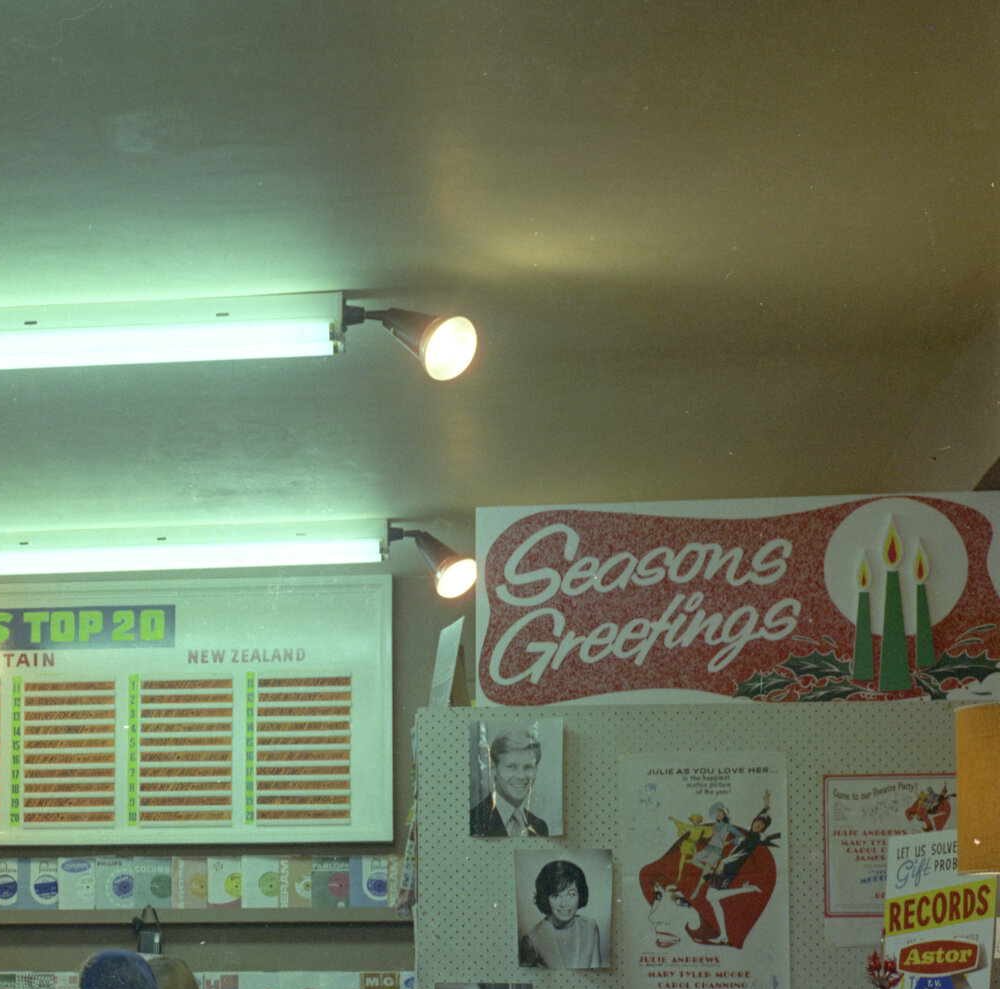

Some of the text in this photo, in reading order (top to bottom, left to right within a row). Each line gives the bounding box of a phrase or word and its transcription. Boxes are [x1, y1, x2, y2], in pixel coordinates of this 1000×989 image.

[495, 522, 793, 608] Seasons
[23, 609, 103, 643] TOP
[111, 608, 166, 642] 20
[488, 590, 802, 687] Greetings
[187, 647, 307, 664] NEW ZEALAND
[647, 768, 674, 776] JULIE
[693, 767, 715, 775] YOU
[897, 840, 958, 860] LET US SOLVE
[894, 857, 931, 889] Gift
[888, 884, 991, 933] RECORDS
[639, 955, 721, 963] JULIE ANDREWS
[903, 946, 973, 966] Astor
